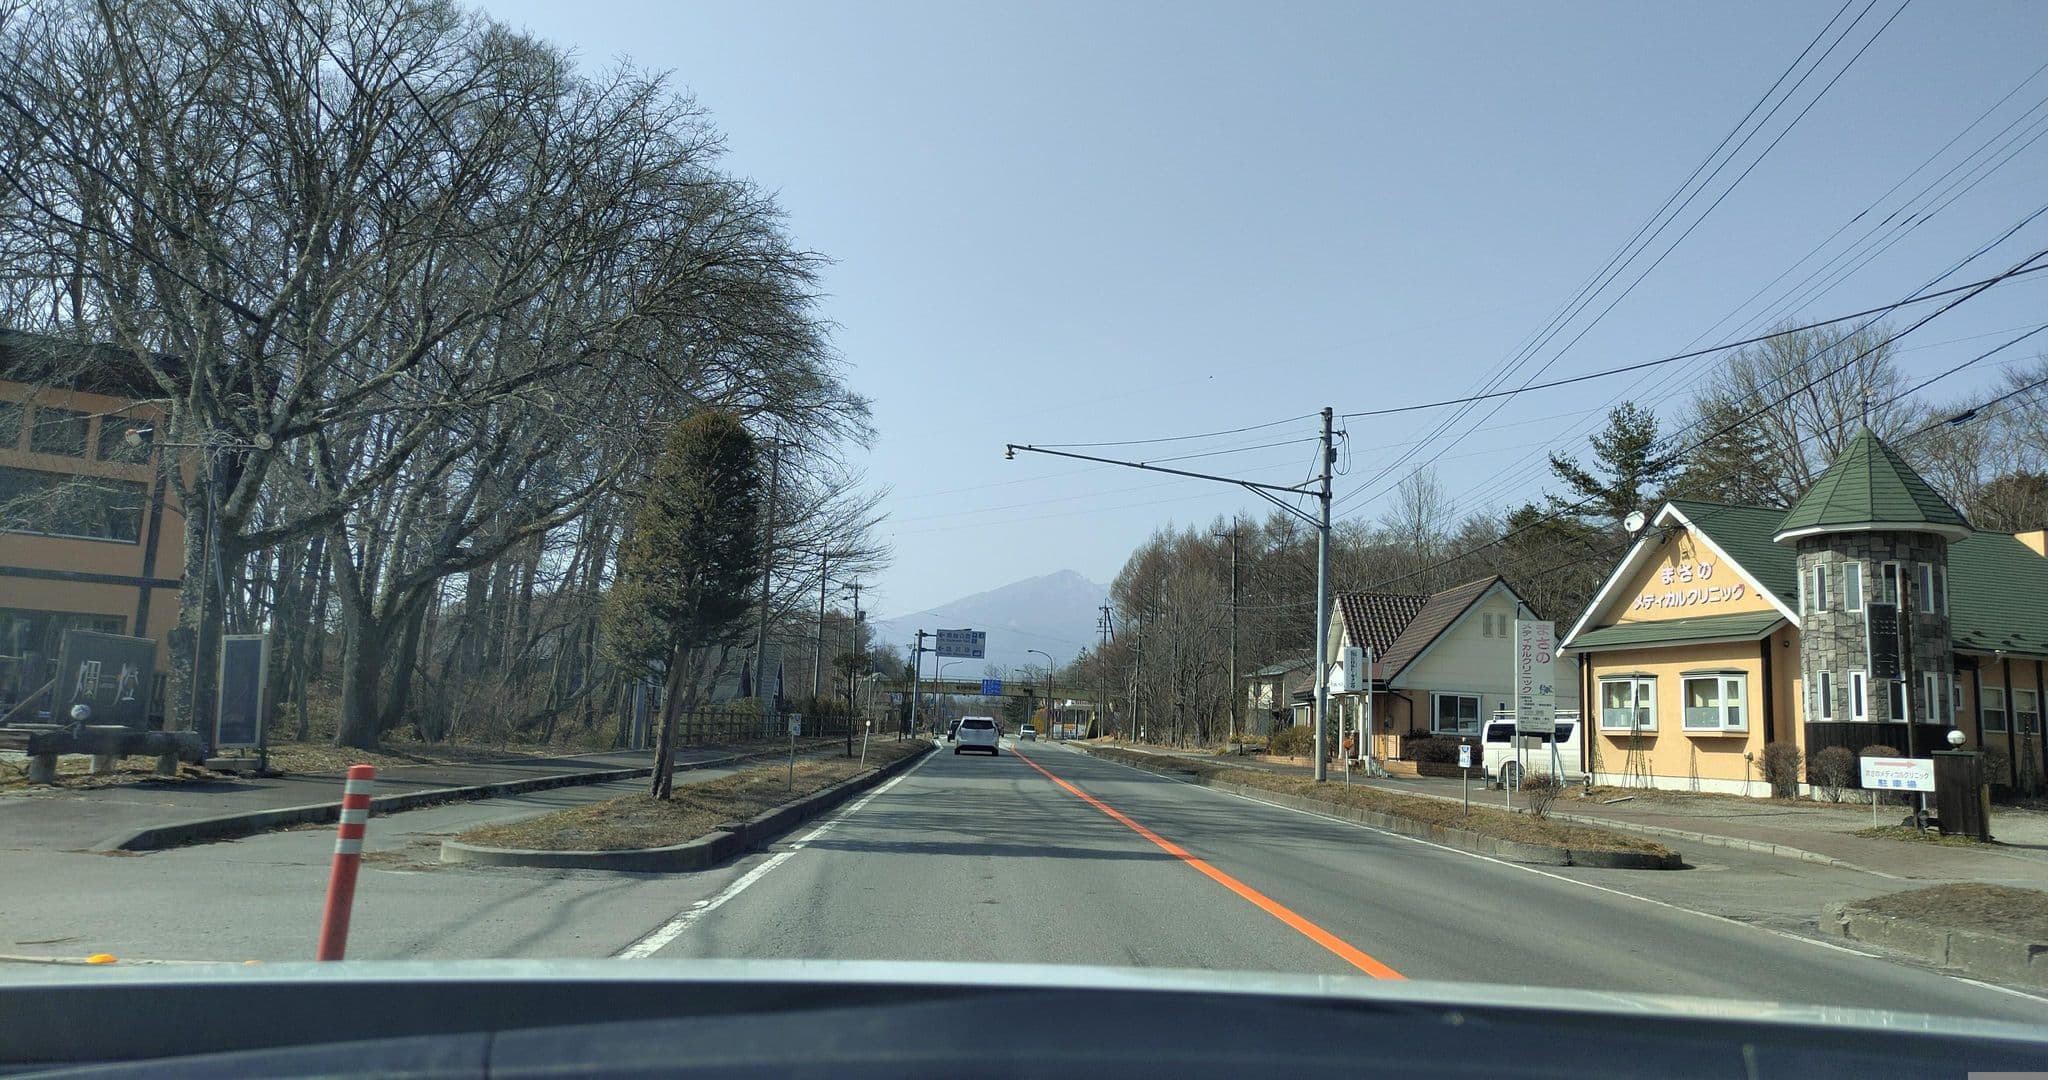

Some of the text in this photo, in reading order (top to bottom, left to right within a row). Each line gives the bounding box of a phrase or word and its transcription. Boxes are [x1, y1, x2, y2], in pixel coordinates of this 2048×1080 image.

[1661, 562, 1713, 585] まさの
[1633, 584, 1745, 610] メディカルクリニック
[1521, 624, 1532, 694] メディカルクリニック
[1535, 624, 1550, 664] まさの
